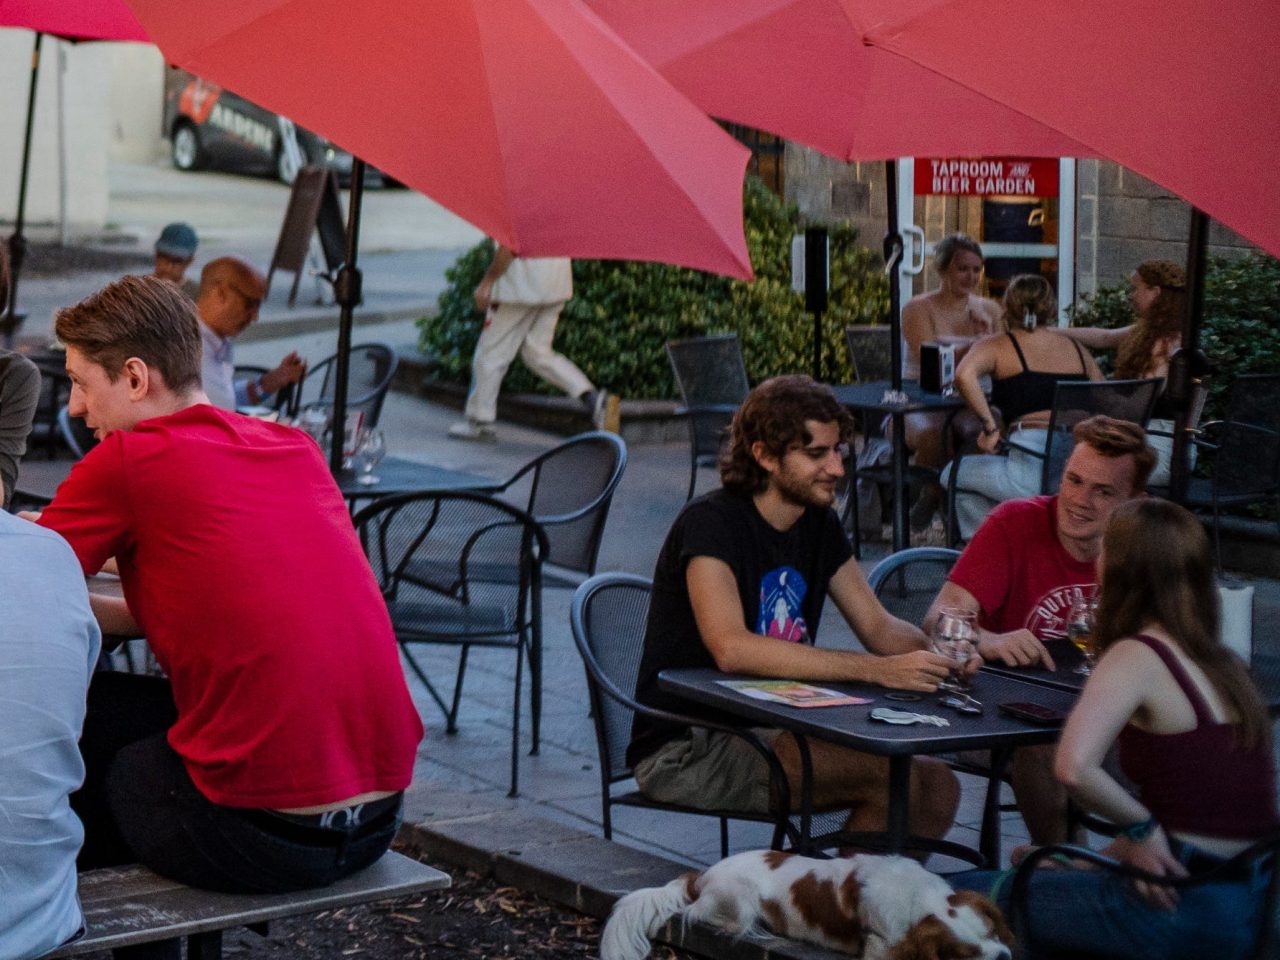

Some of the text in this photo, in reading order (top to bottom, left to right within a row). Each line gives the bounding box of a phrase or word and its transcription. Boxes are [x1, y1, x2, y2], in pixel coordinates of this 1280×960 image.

[931, 160, 1003, 177] TAPROOM
[932, 177, 1035, 194] BEER GARDEN
